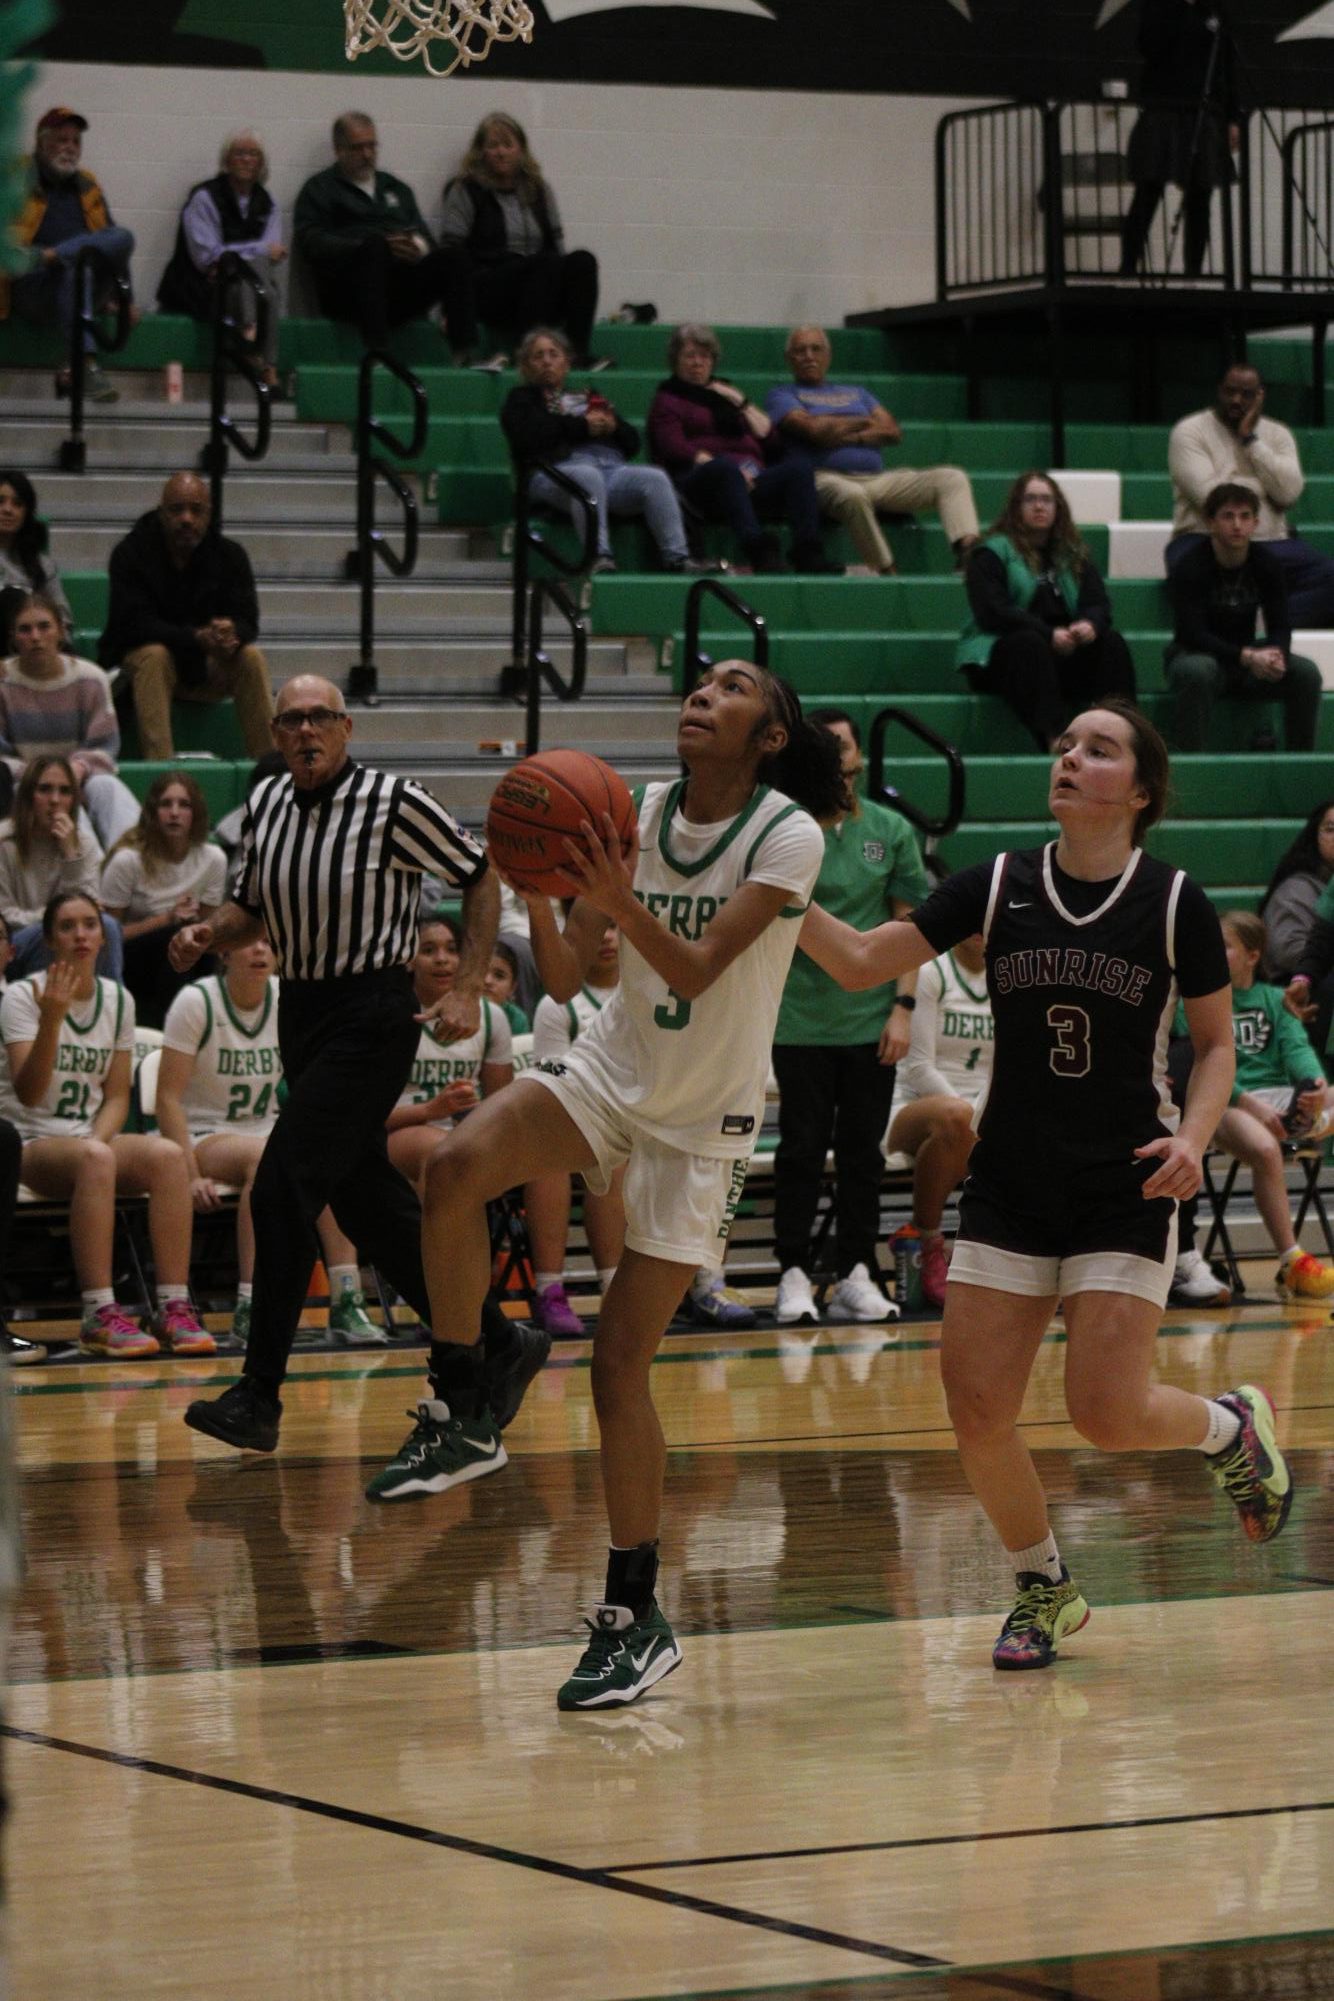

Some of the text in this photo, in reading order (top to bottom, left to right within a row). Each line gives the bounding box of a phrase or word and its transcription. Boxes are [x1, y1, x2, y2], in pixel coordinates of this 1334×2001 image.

[633, 890, 729, 941] ERB
[994, 948, 1152, 1007] SUNRISE
[57, 1044, 112, 1075] ERBY
[1046, 1004, 1091, 1078] 3
[53, 1080, 88, 1120] 21
[226, 1082, 273, 1121] 24
[717, 1156, 750, 1239] PANTHE
